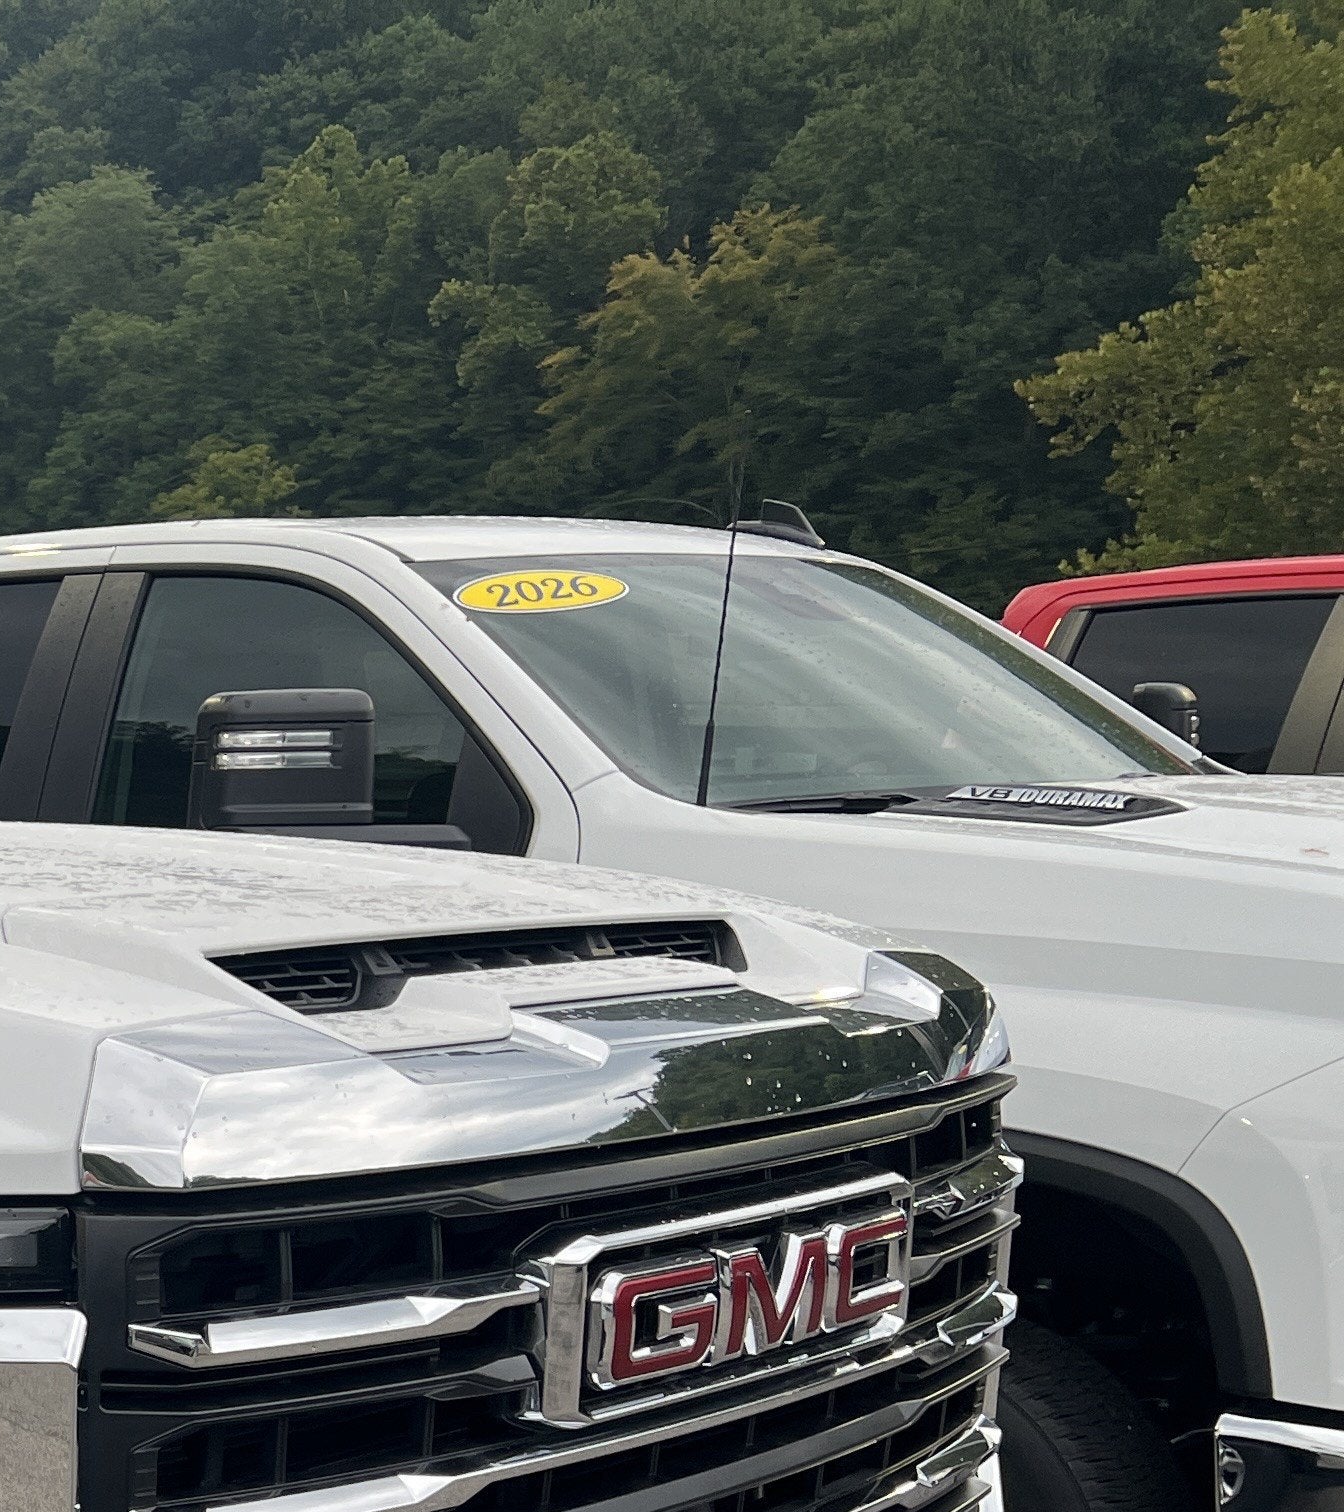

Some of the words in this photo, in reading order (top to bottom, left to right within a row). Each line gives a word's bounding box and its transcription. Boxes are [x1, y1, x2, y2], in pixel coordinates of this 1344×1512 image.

[486, 576, 598, 607] 2026
[971, 787, 1012, 799] V8
[1017, 788, 1133, 810] DURAMAX
[588, 1206, 909, 1391] GMC
